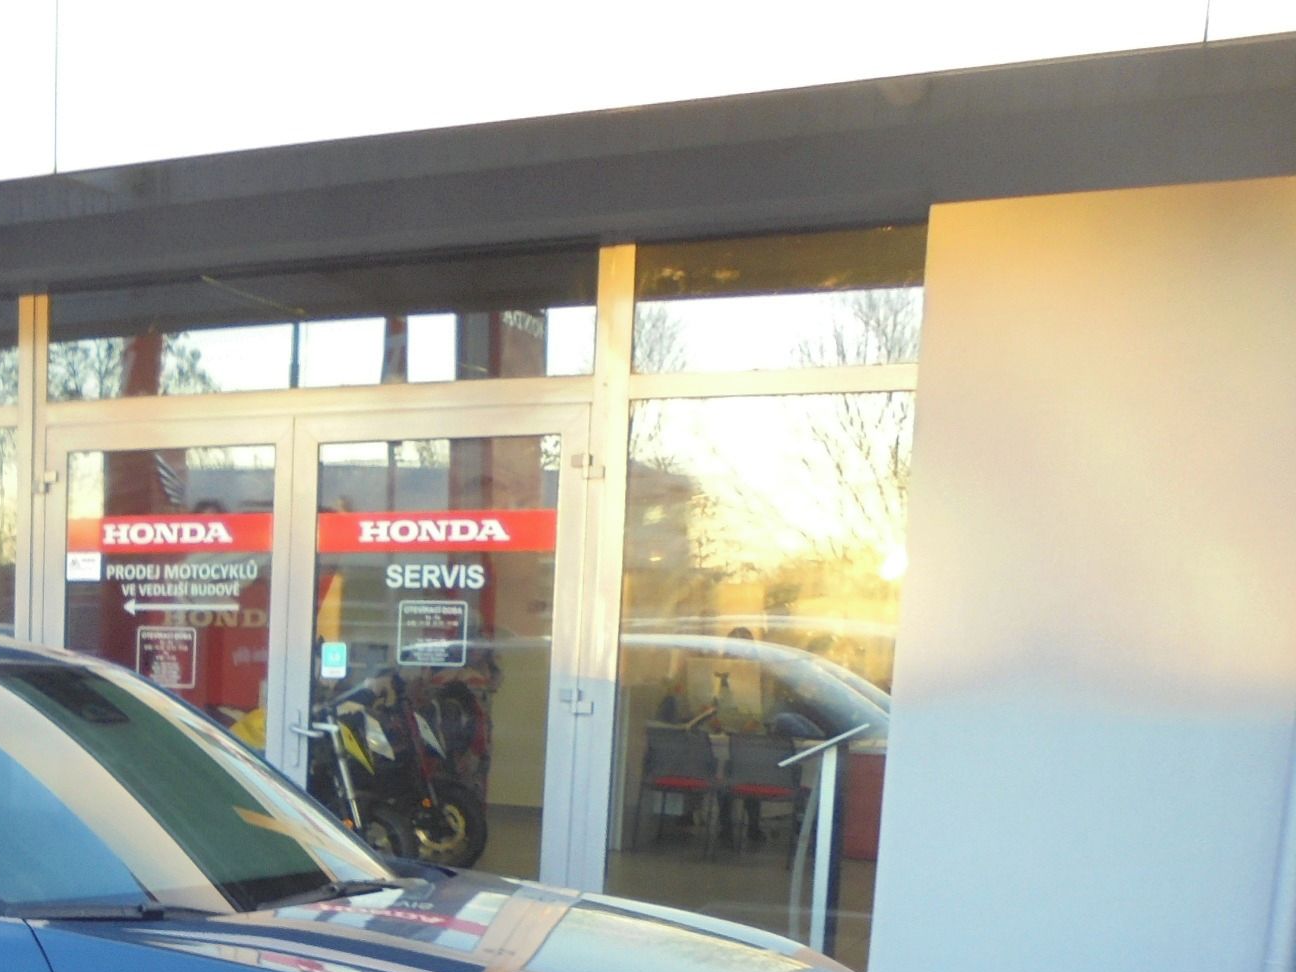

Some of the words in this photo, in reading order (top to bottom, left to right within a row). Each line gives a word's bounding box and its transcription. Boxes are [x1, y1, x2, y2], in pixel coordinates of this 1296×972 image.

[102, 521, 234, 545] HONDA
[357, 518, 511, 543] HONDA
[106, 562, 160, 580] PRODEJ
[164, 559, 259, 580] MOTOCYKLŮ
[385, 563, 486, 589] SERVIS
[121, 583, 136, 597] VE
